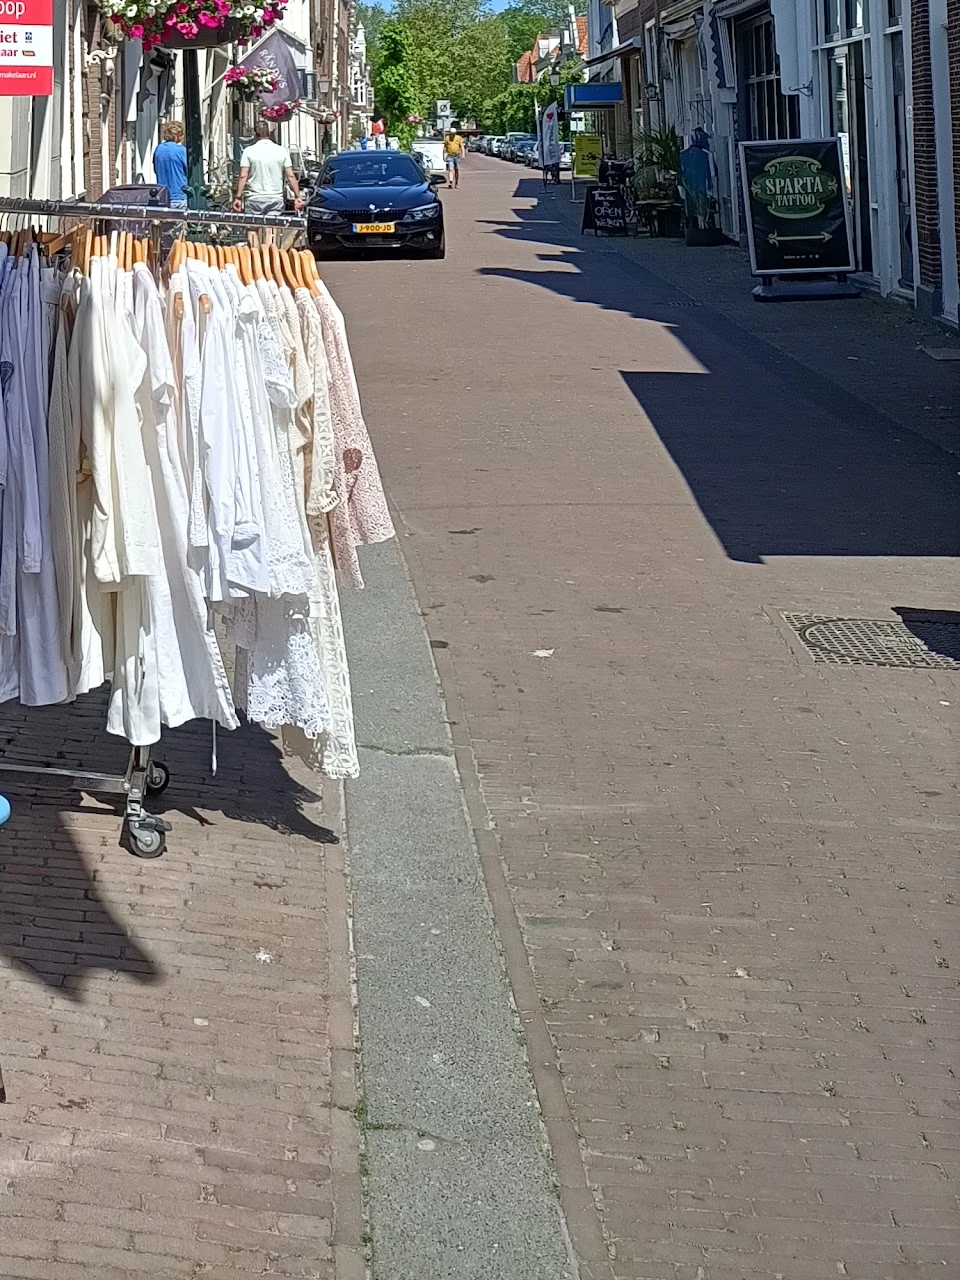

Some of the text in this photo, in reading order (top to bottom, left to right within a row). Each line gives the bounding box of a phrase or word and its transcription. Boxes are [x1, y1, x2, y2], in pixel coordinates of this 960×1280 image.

[765, 176, 823, 195] SPARTA
[775, 194, 815, 207] TATTOO
[595, 207, 622, 216] OPEN
